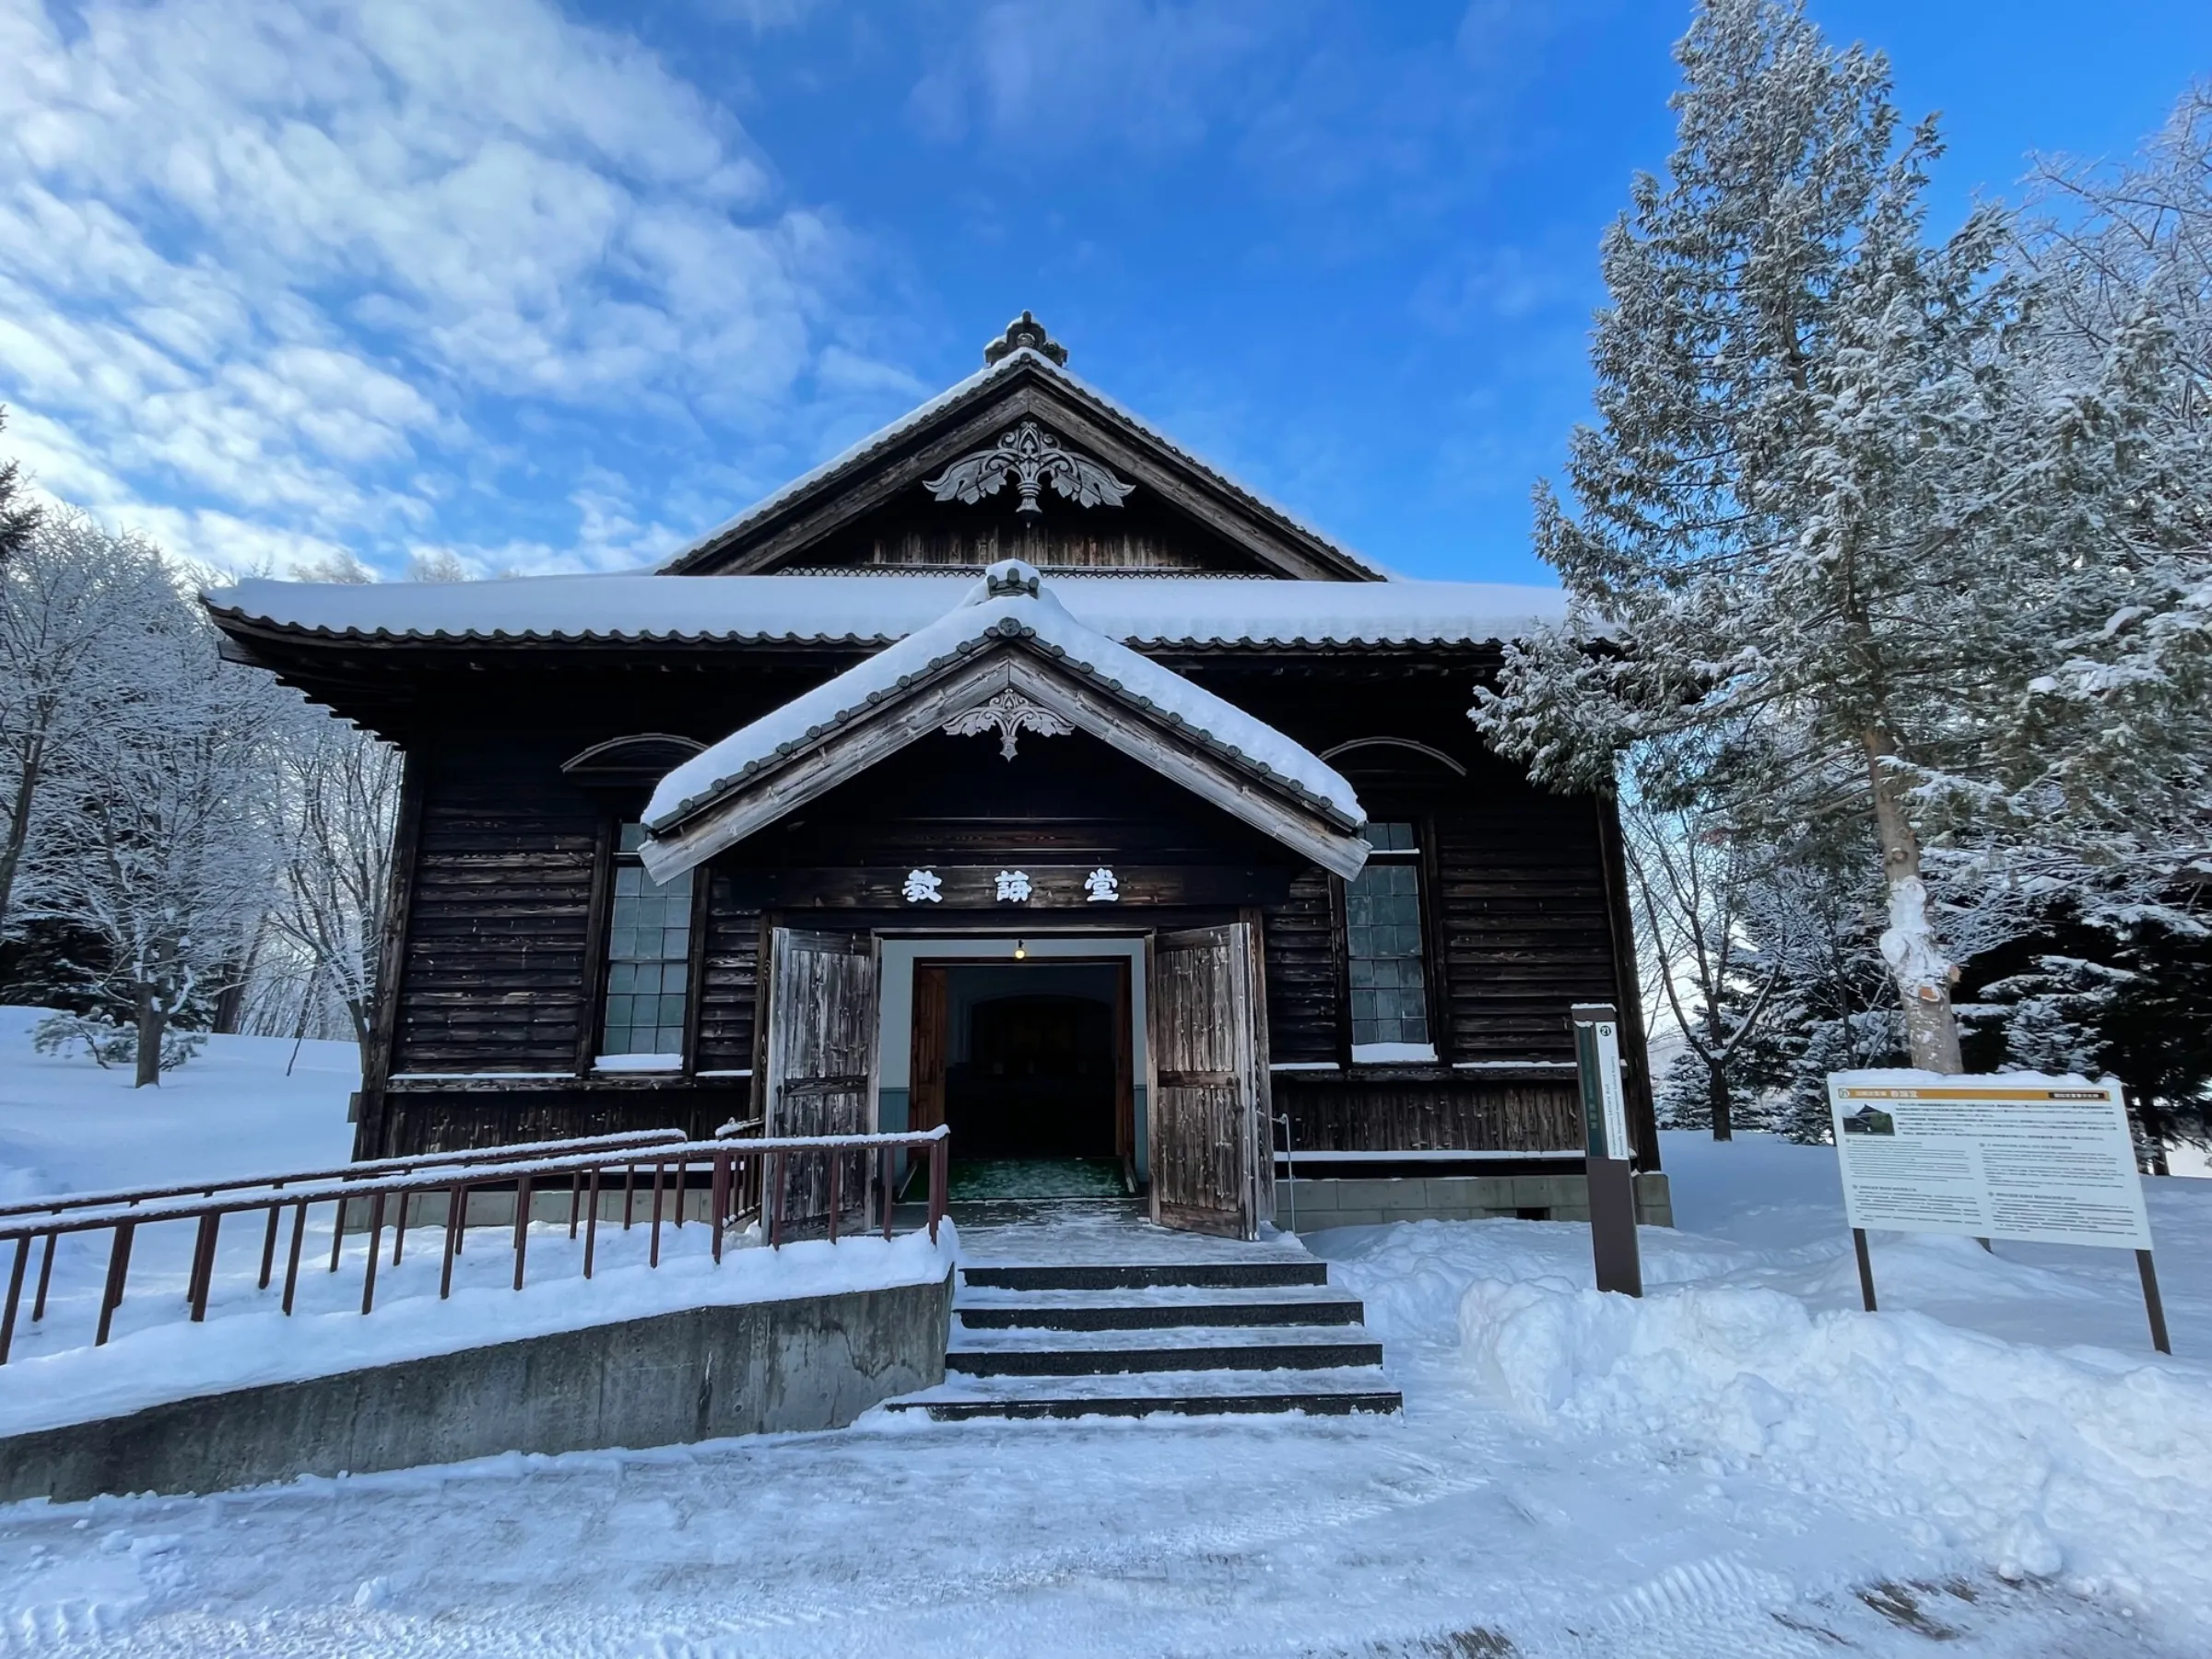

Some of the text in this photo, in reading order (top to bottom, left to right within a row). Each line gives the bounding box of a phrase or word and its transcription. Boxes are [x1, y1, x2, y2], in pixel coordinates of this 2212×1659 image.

[902, 868, 1119, 903] 教誨堂
[1601, 1026, 1610, 1036] 21
